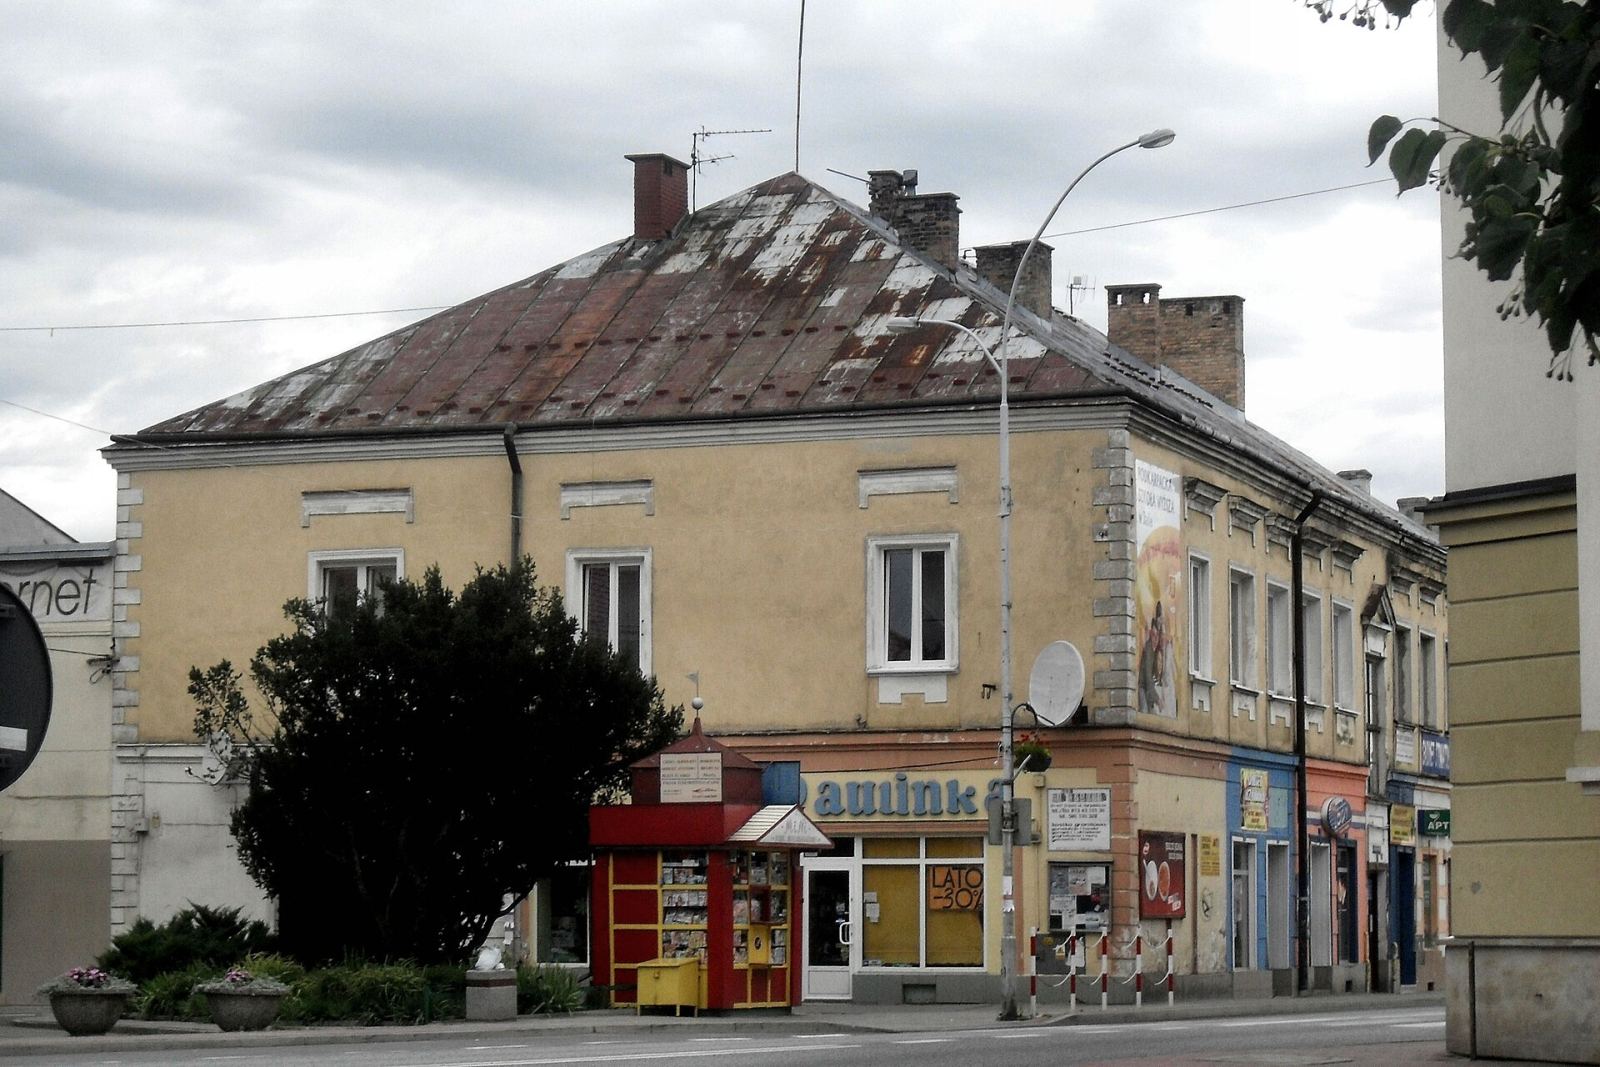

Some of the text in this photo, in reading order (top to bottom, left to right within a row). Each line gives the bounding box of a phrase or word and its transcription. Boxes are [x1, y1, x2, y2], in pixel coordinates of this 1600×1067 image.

[3, 568, 97, 616] rnet
[800, 772, 1003, 816] aulink
[1427, 821, 1449, 830] APT
[932, 864, 984, 889] LATO
